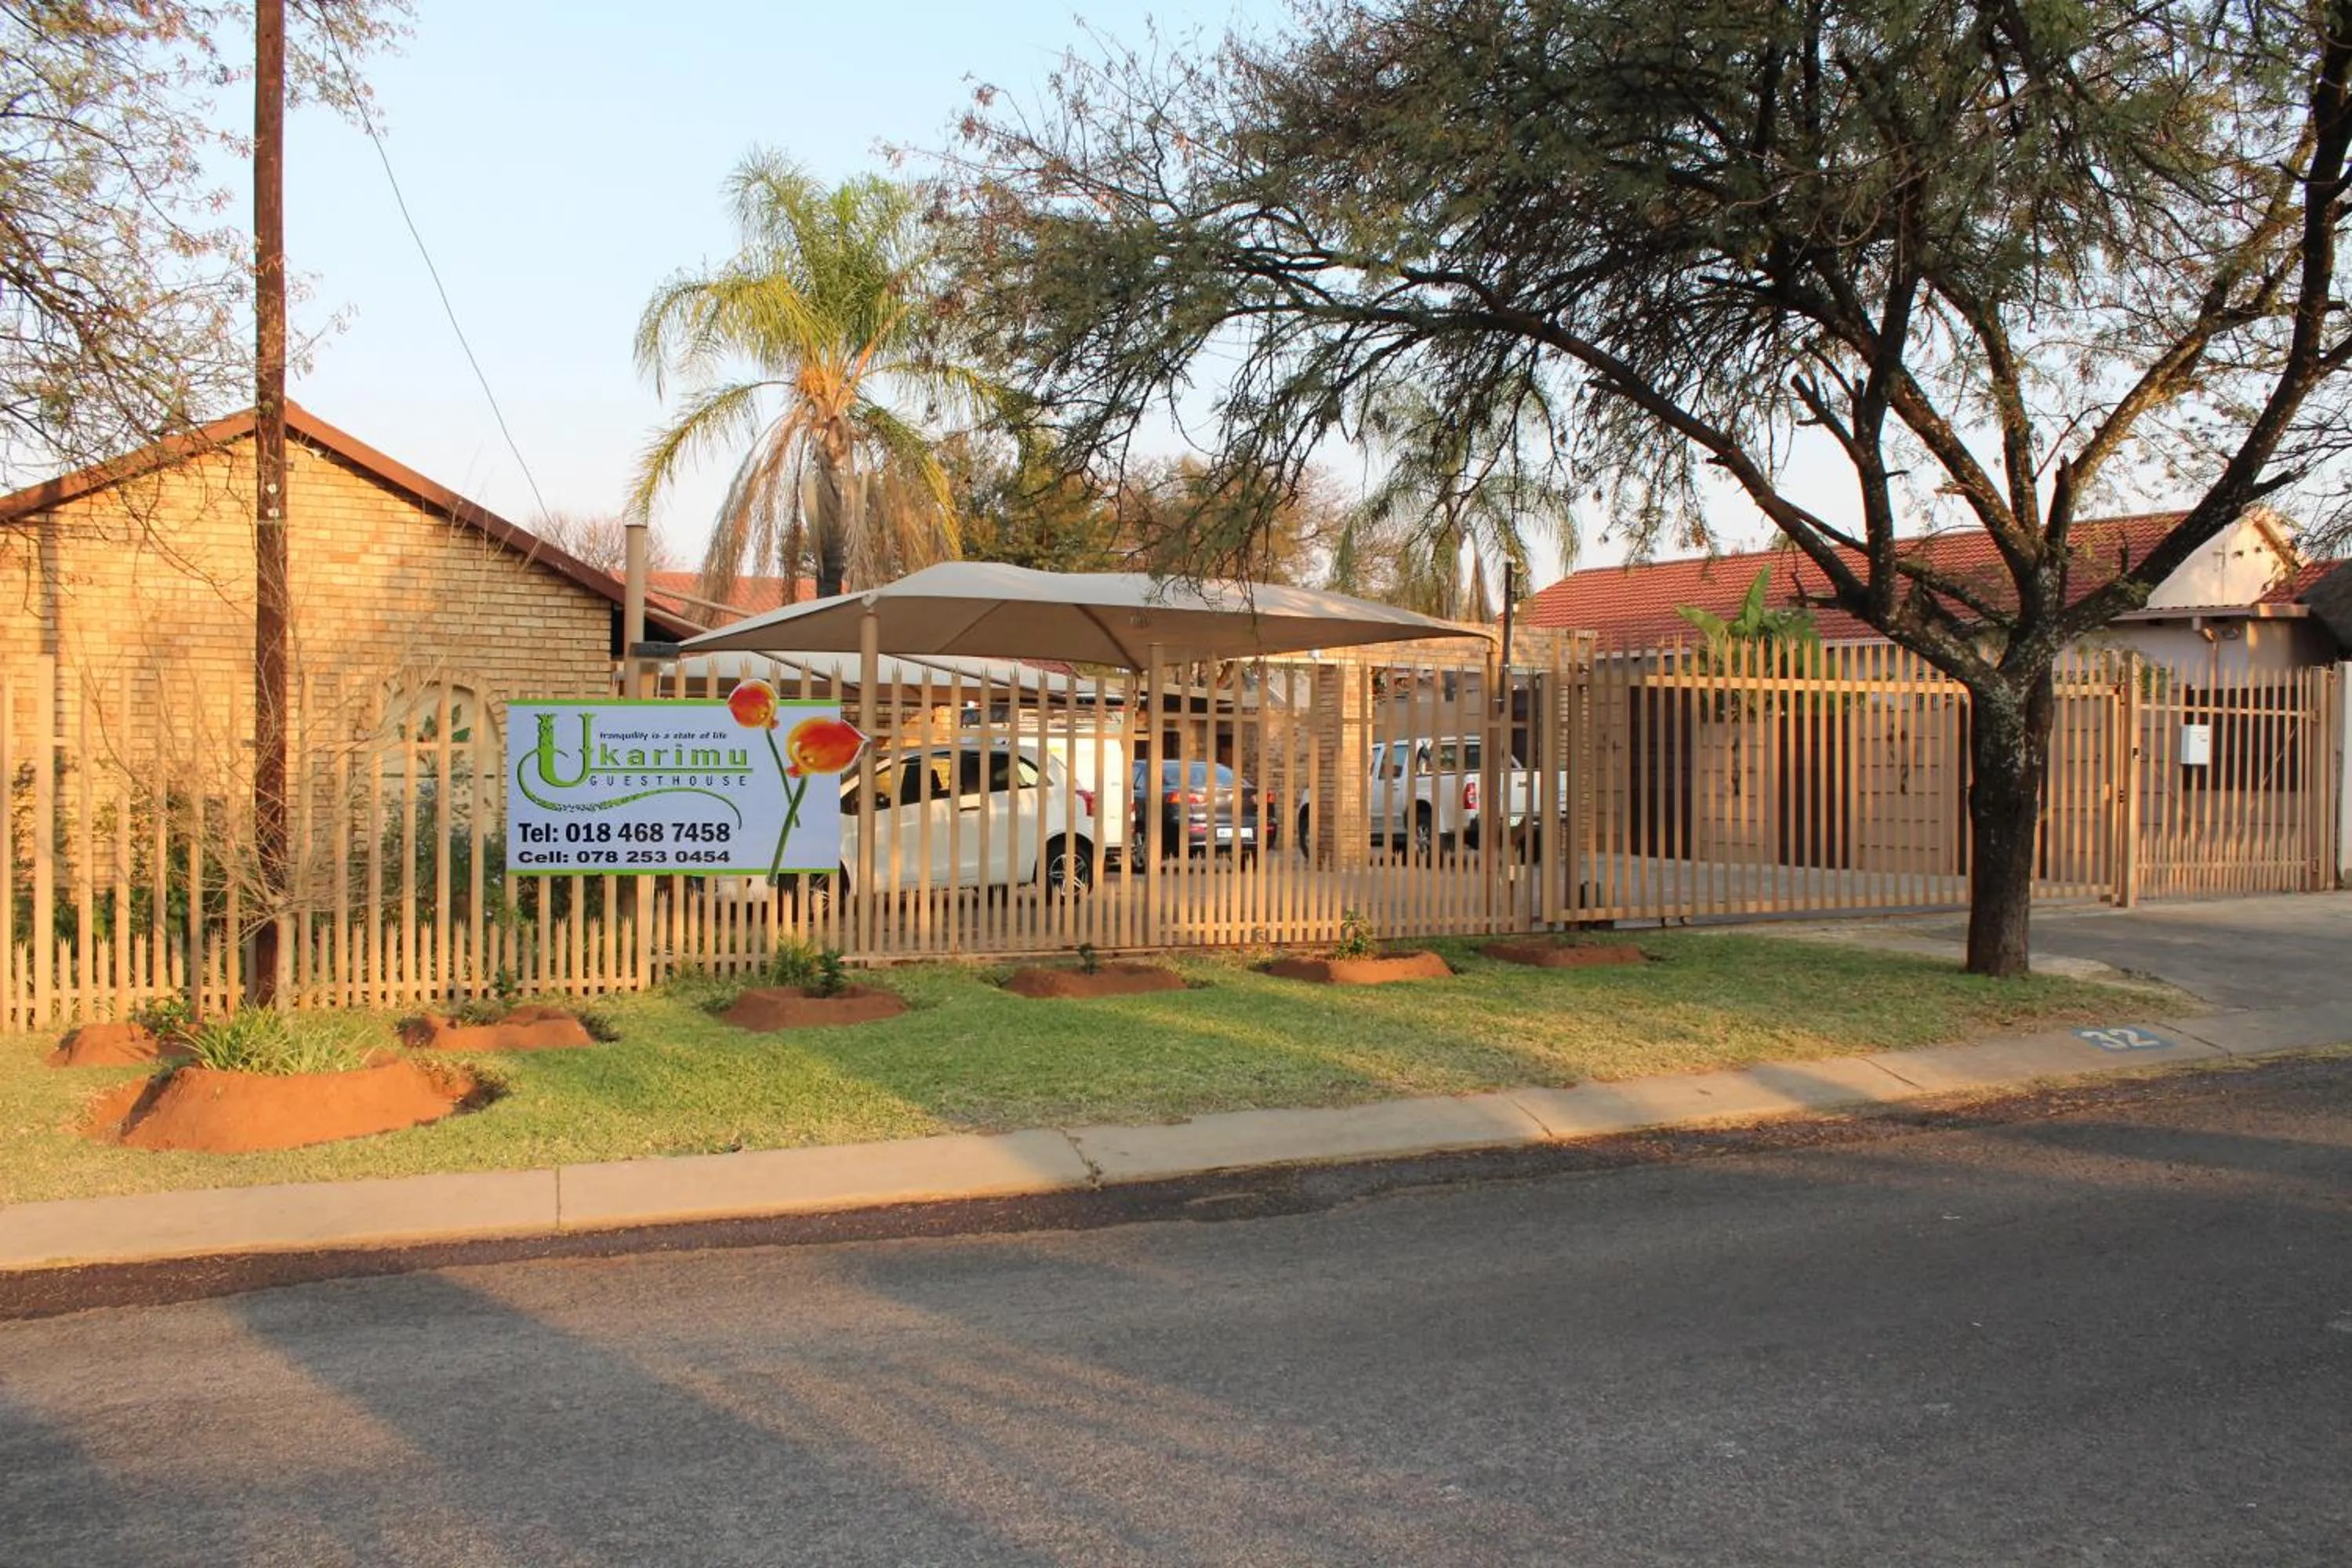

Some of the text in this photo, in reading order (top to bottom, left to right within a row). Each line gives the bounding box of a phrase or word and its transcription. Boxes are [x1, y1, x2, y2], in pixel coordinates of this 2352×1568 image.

[590, 775, 747, 786] GUESTHOUSE
[518, 822, 731, 843] Tel: 018 468 7458
[518, 851, 731, 863] Cell: 078 253 0454
[2080, 1028, 2161, 1049] 32
